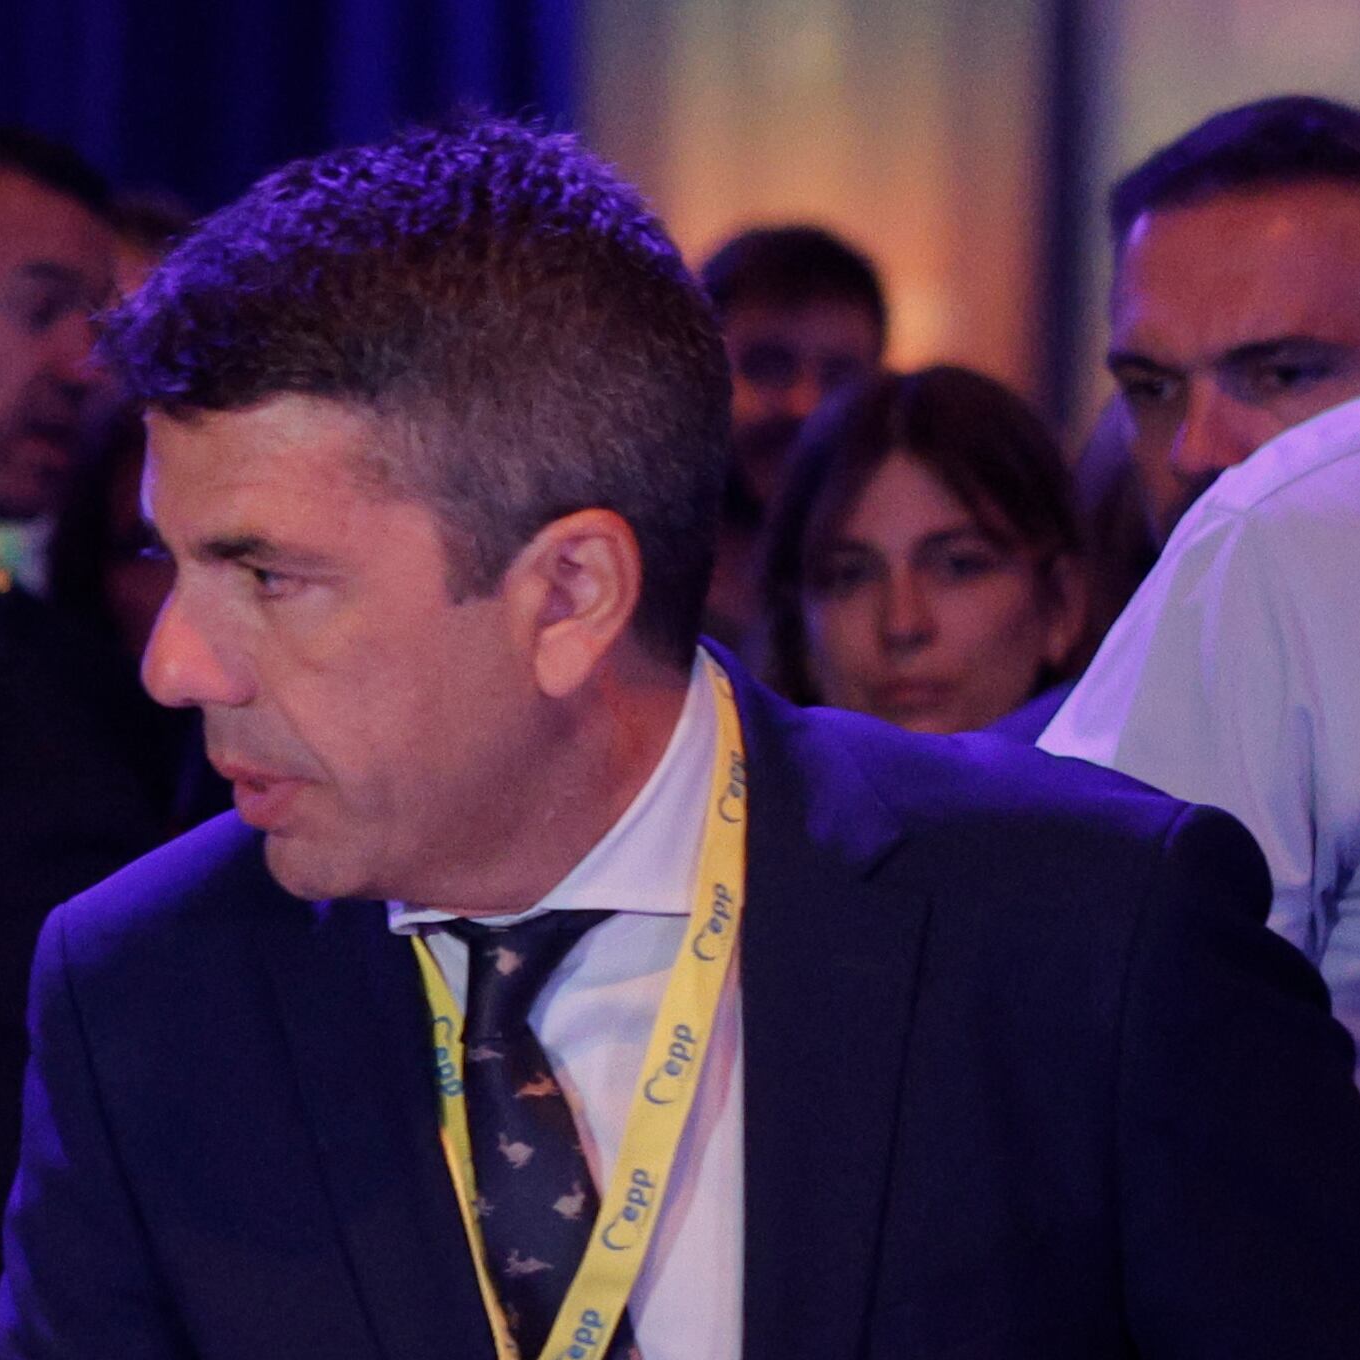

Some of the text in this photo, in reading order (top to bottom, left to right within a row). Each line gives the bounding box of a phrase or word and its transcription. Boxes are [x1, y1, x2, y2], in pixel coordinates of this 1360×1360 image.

[710, 884, 733, 935] epp
[665, 1024, 697, 1077] epp
[622, 1168, 655, 1222] epp
[568, 1308, 605, 1360] epp
